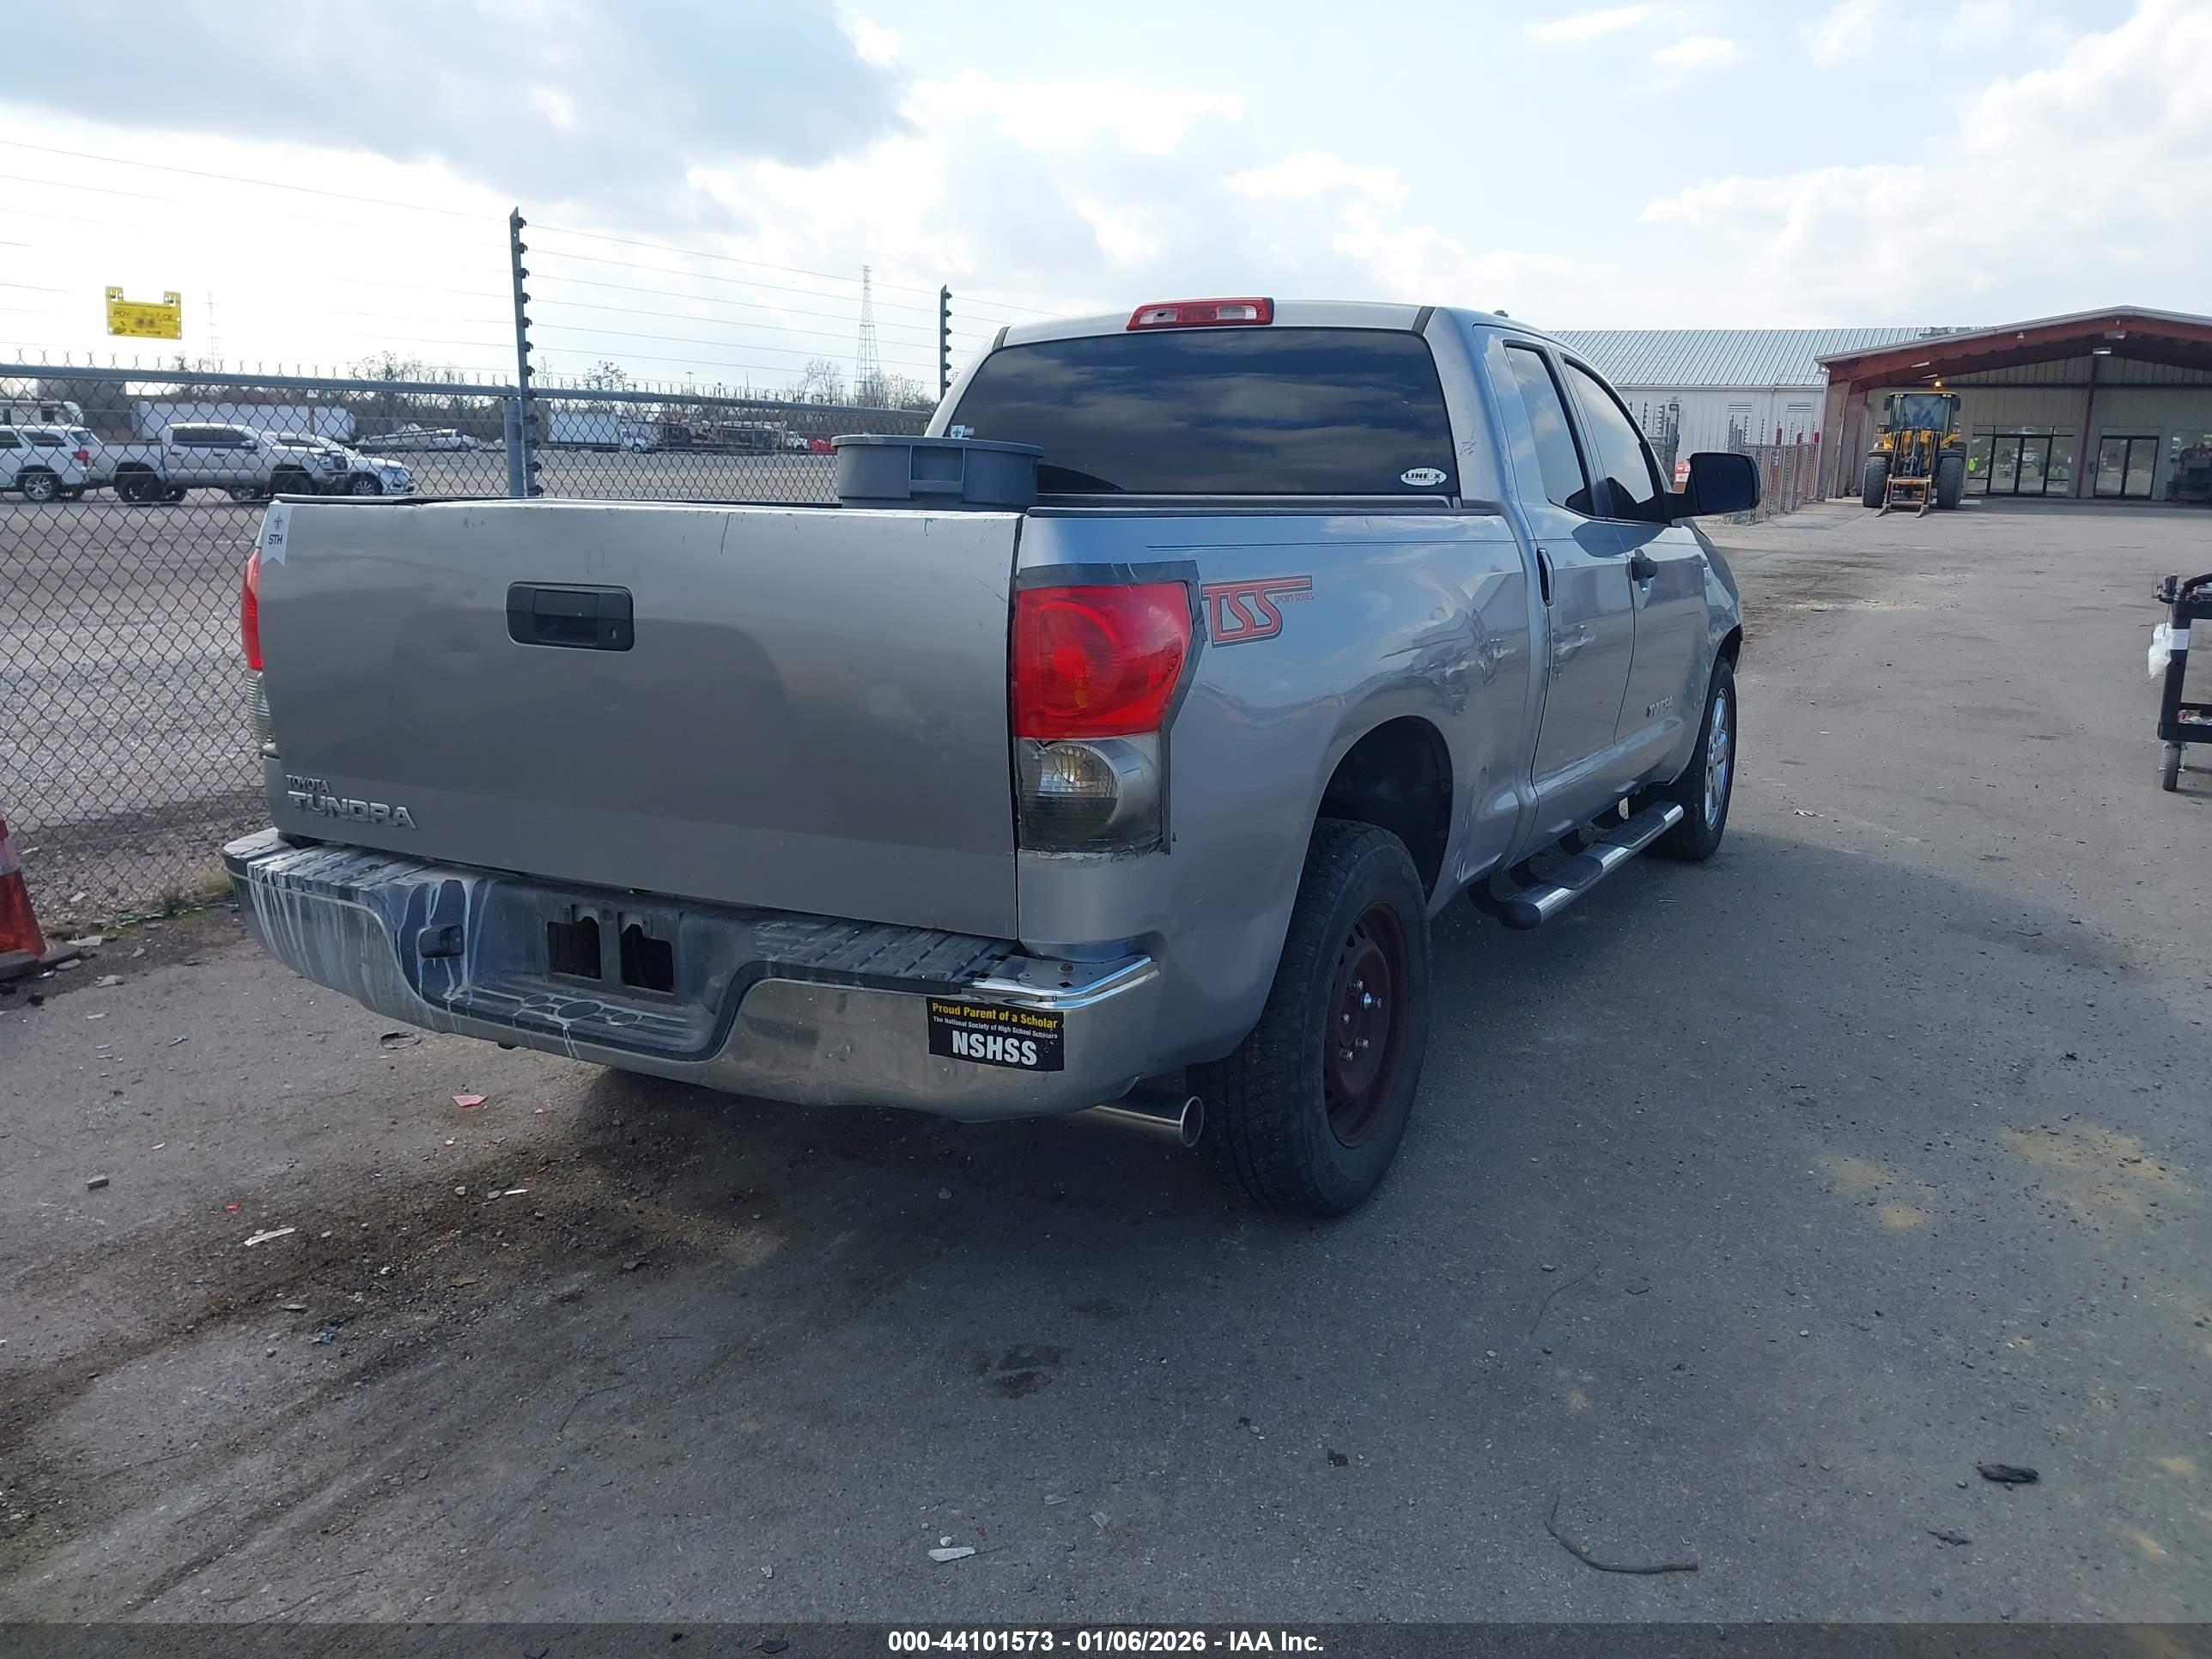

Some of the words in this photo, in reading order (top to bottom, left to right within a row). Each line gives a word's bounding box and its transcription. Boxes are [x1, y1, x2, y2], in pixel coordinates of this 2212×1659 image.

[1201, 574, 1313, 649] TSS
[1273, 594, 1293, 605] SPORT
[286, 775, 331, 793] TOYOTA
[288, 790, 417, 830] TUNDRA
[932, 1002, 961, 1016] Proud
[963, 1006, 997, 1020] Parent
[999, 1010, 1010, 1022] of
[1012, 1014, 1018, 1023] a
[1020, 1013, 1059, 1029] Scholar
[945, 1018, 967, 1028] National
[968, 1021, 989, 1031] Society
[998, 1024, 1012, 1034] High
[1012, 1027, 1031, 1036] School
[951, 1030, 1037, 1066] NSHSS
